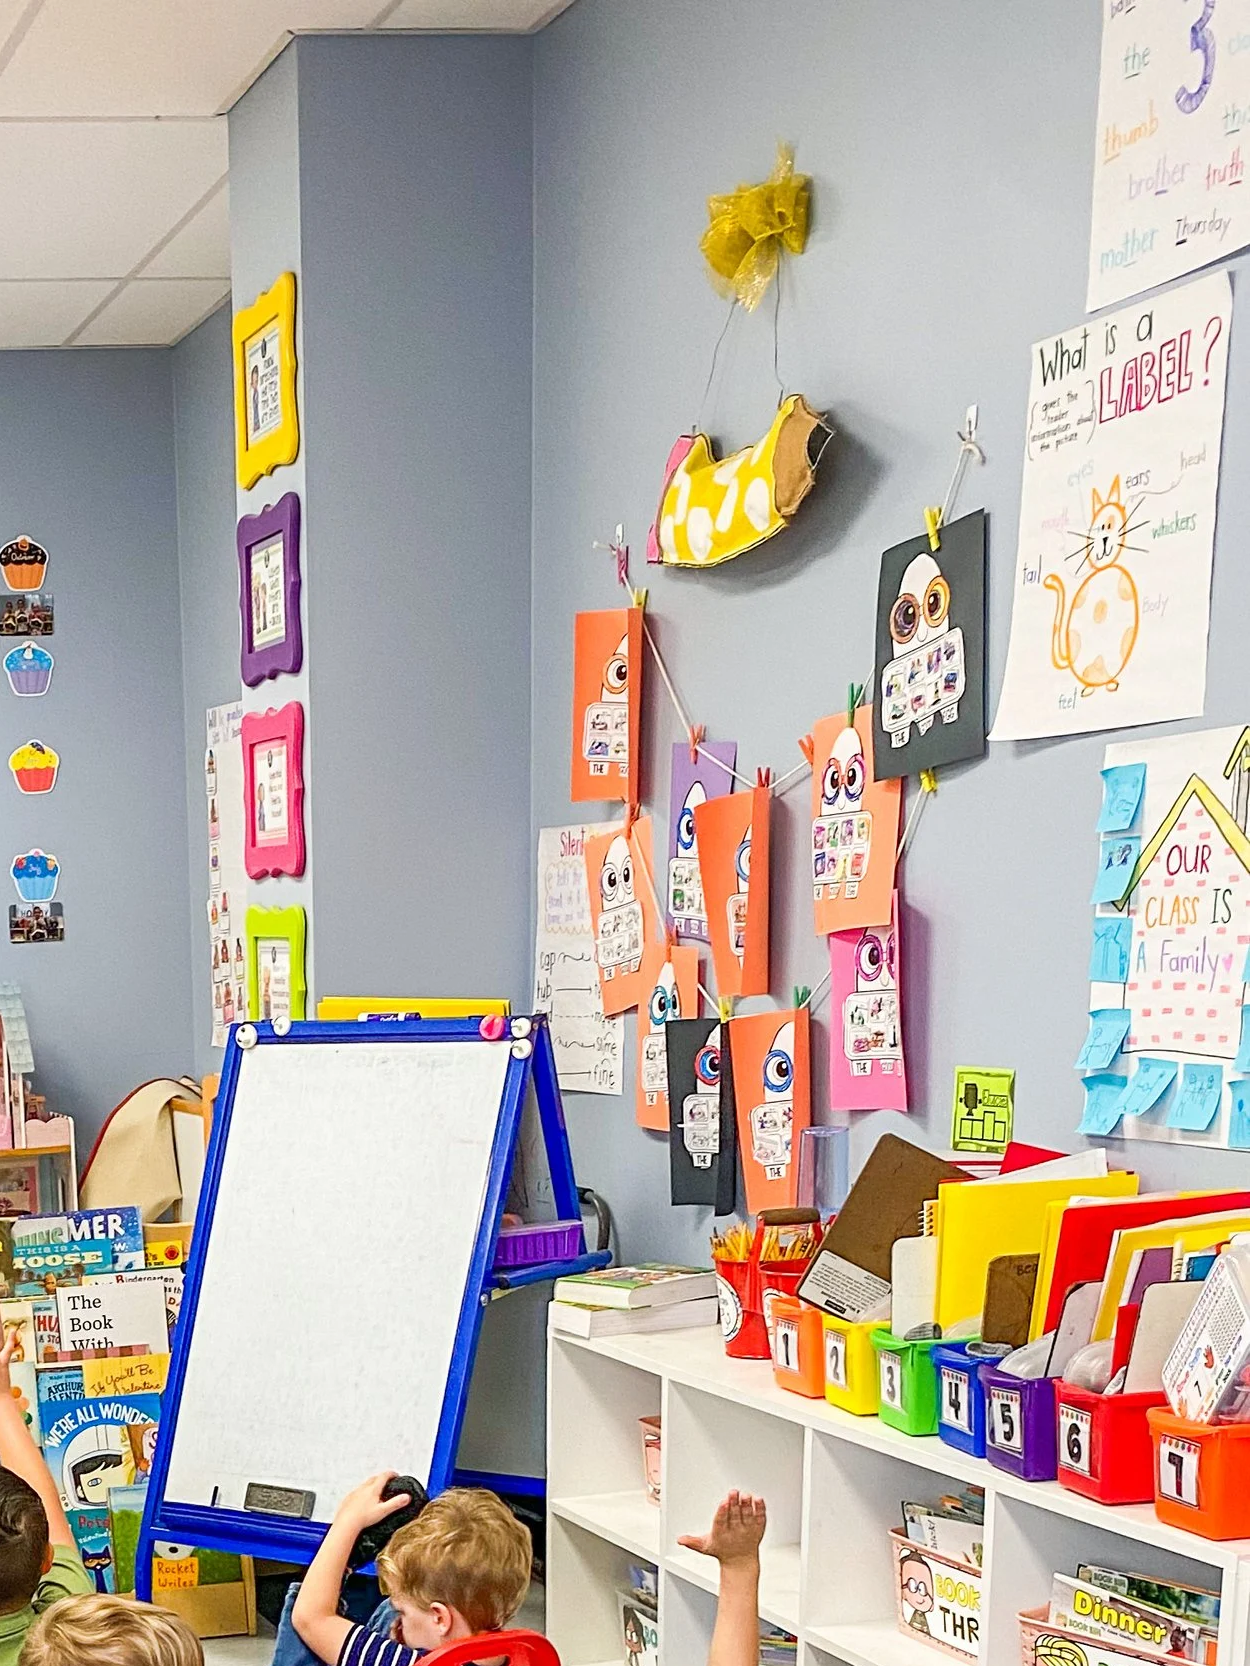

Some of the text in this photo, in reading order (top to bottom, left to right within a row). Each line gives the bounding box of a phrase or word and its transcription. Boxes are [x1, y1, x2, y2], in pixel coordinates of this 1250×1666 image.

[1124, 42, 1150, 72] the
[1104, 100, 1159, 154] thumb
[1129, 155, 1190, 200] brother
[1206, 147, 1244, 190] truth
[1176, 208, 1231, 241] Thursday
[1101, 228, 1158, 272] mother
[1040, 311, 1154, 387] What is a
[1125, 470, 1151, 489] ears
[1152, 511, 1197, 539] whiskers
[1023, 555, 1042, 585] tail
[593, 763, 604, 773] THE
[560, 827, 585, 857] Silent
[1166, 844, 1212, 877] OUR
[1145, 888, 1233, 930] CLASS IS
[1136, 936, 1219, 992] A Family
[537, 978, 552, 999] tub
[856, 1062, 867, 1073] THE
[770, 1167, 783, 1178] THE
[67, 1213, 125, 1242] MER
[16, 1247, 51, 1256] THIS
[54, 1245, 68, 1253] IS
[68, 1295, 101, 1310] The
[70, 1315, 113, 1332] Book
[71, 1338, 113, 1350] With
[781, 1333, 790, 1365] 1
[91, 1384, 105, 1396] If
[135, 1364, 154, 1376] Be
[830, 1348, 840, 1381] 2
[886, 1368, 896, 1402] 3
[948, 1385, 961, 1421] 4
[45, 1412, 78, 1448] WE'RE
[76, 1404, 99, 1425] ALL
[1002, 1403, 1014, 1442] 5
[1067, 1426, 1082, 1463] 6
[1167, 1452, 1184, 1497] 7
[157, 1562, 195, 1574] Rocket
[935, 1574, 981, 1611] BOOK
[1074, 1589, 1167, 1644] Dinner
